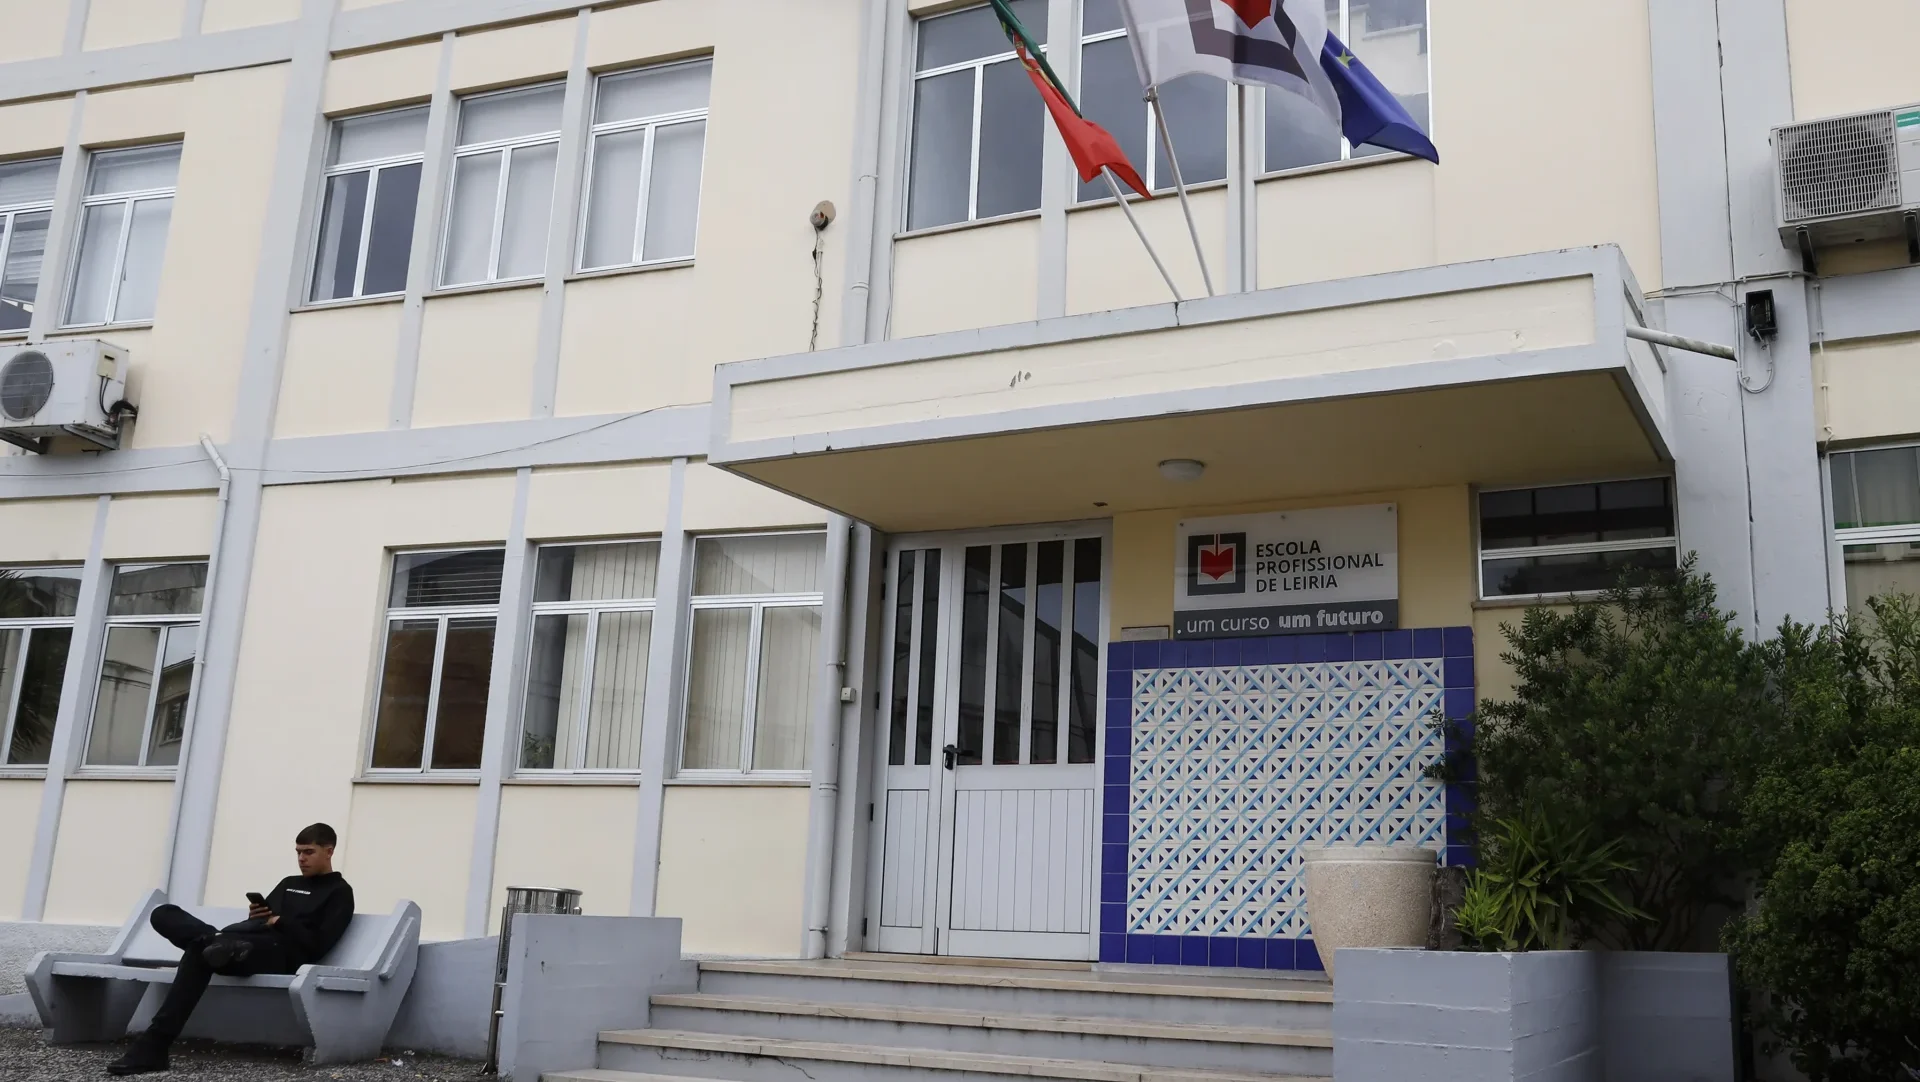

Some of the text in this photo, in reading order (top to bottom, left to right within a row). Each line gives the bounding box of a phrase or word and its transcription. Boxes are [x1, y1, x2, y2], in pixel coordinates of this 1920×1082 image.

[1256, 540, 1321, 558] ESCOLA
[1256, 553, 1383, 575] PROFISSIONAL
[1256, 574, 1338, 593] DE LEIRIA
[1187, 609, 1383, 633] um curso um futuro
